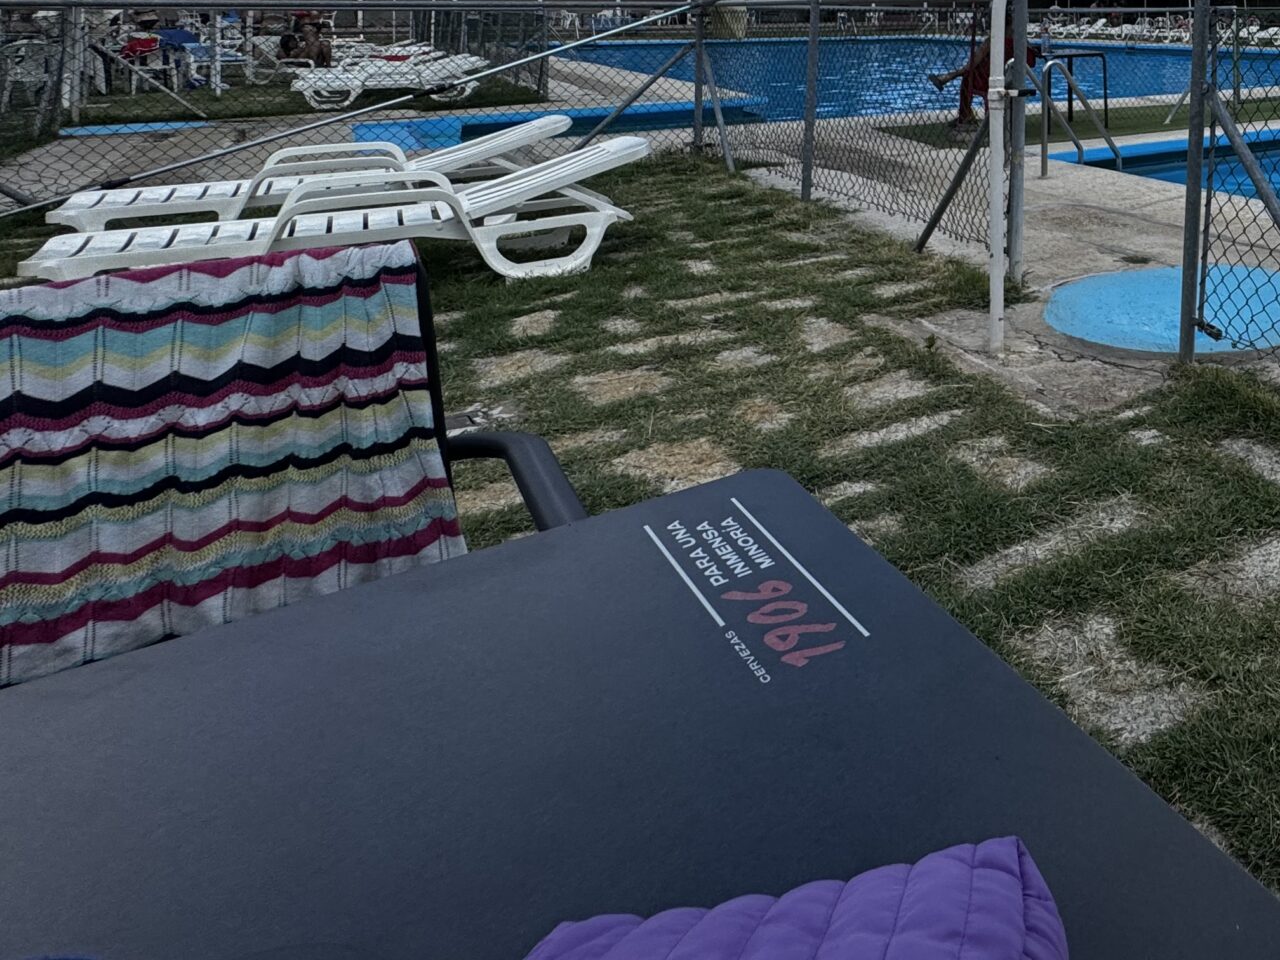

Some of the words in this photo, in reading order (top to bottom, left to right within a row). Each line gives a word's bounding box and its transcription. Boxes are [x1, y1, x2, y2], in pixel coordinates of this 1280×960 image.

[666, 519, 697, 549] UNA
[696, 520, 753, 578] INMENSA
[720, 516, 776, 569] MINORÍA
[689, 547, 729, 587] PARA
[720, 580, 846, 667] 1906
[725, 630, 771, 683] CERVEZAS
